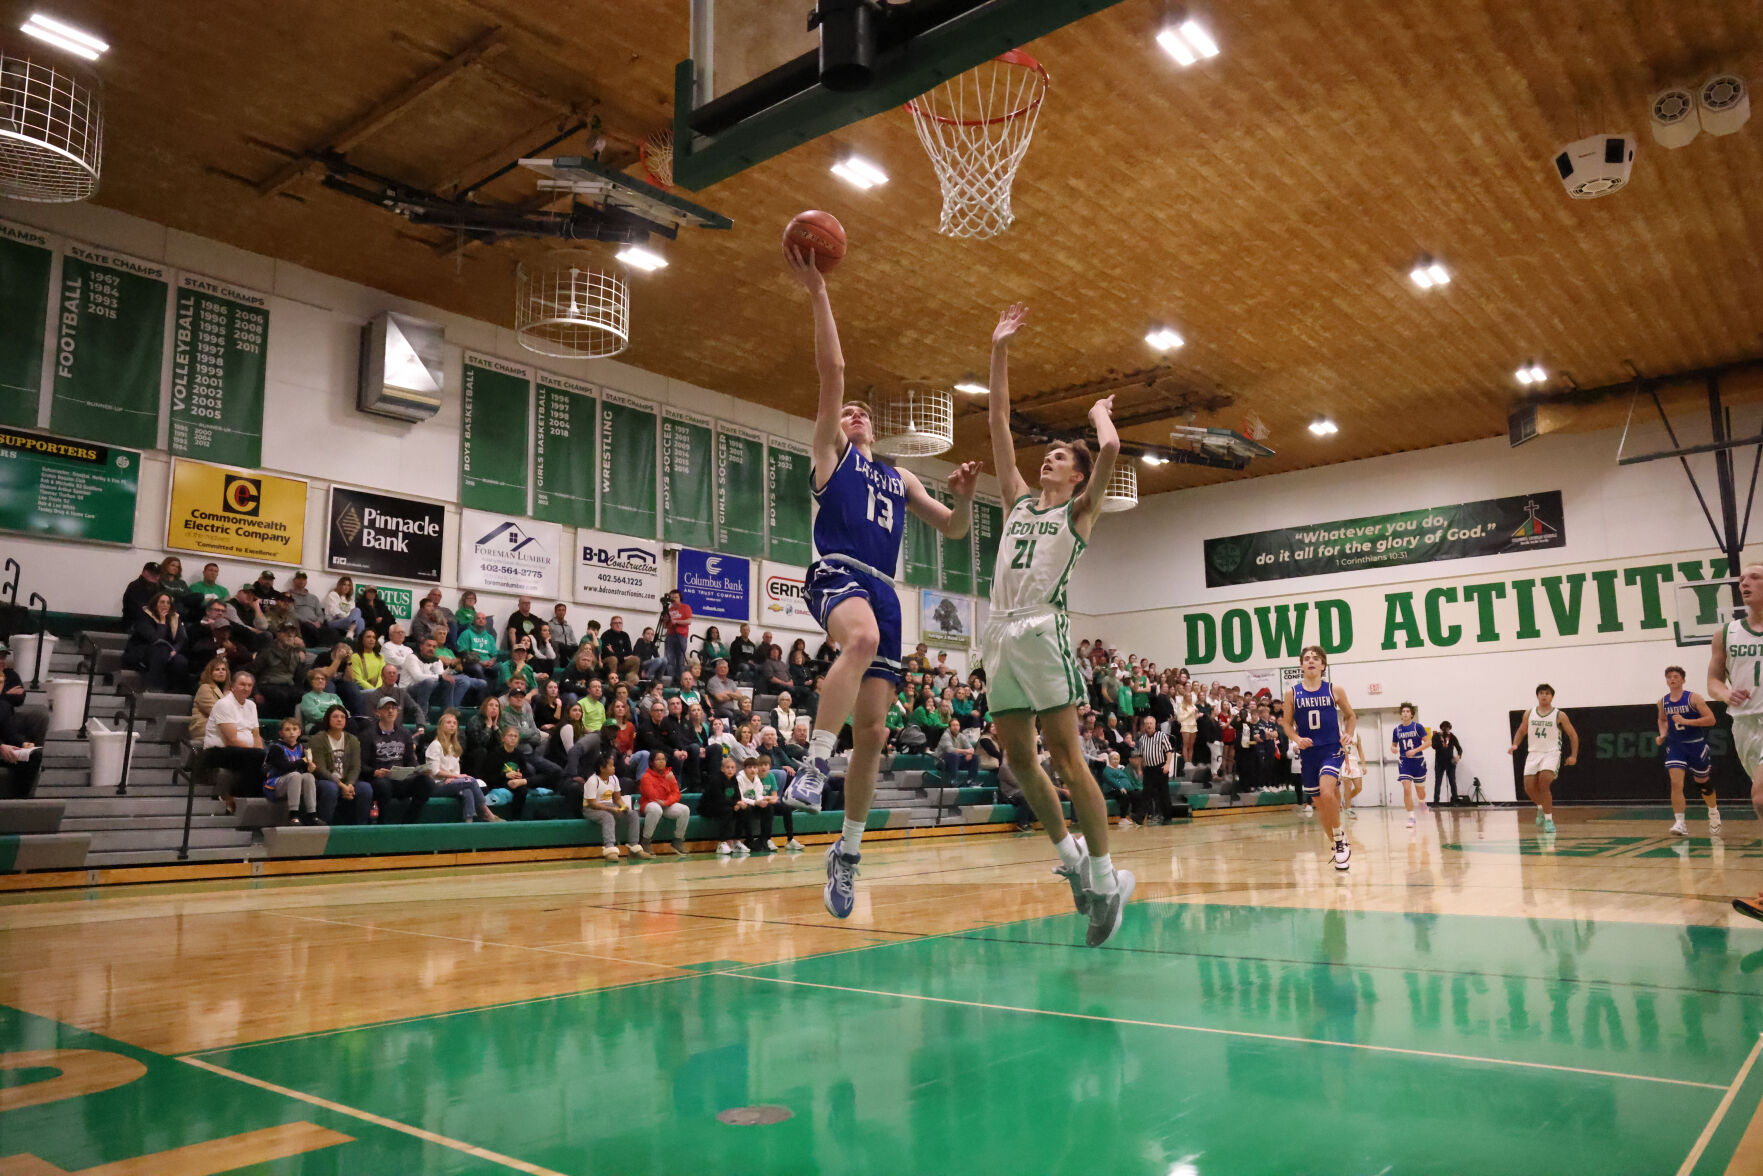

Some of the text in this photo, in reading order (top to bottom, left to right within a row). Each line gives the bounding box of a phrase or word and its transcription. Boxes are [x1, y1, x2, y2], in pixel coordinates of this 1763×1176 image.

[71, 246, 163, 278] STATE CHAMPS
[90, 271, 120, 285] 1967
[89, 281, 119, 297] 1984
[184, 277, 265, 306] STATE CHAMPS
[89, 292, 118, 308] 1993
[201, 300, 228, 314] 1986
[88, 303, 117, 319] 2015
[200, 310, 226, 324] 1990
[58, 277, 82, 378] FOOTBALL
[198, 331, 225, 345] 1996
[236, 341, 259, 353] 2011
[173, 296, 195, 412] VOLLEYBALL
[197, 342, 224, 355] 1997
[196, 352, 224, 366] 1998
[468, 355, 527, 377] STATE CHAMPS
[195, 363, 223, 376] 1999
[195, 374, 223, 387] 2001
[540, 375, 593, 395] STATE CHAMPS
[192, 384, 222, 398] 2002
[192, 395, 222, 409] 2003
[464, 370, 475, 439] BASKETBALL
[190, 406, 222, 419] 2005
[538, 388, 546, 454] BASKETBALL
[0, 434, 97, 460] SUPPORTERS
[602, 410, 613, 493] WRESTLING
[663, 423, 672, 473] SOCCER
[718, 434, 727, 484] SOCCER
[537, 457, 545, 487] GIRLS
[866, 483, 894, 534] 13
[191, 509, 287, 531] Commonwealth
[364, 508, 440, 537] Pinnacle
[1385, 520, 1417, 536] you
[1422, 514, 1449, 529] do,
[184, 519, 230, 534] Electric
[235, 527, 290, 546] Company
[362, 529, 408, 552] Bank
[974, 504, 982, 573] JOURNALISM
[474, 545, 516, 559] FOREMAN
[517, 551, 551, 564] LUMBER
[583, 546, 609, 564] B-D
[1011, 540, 1037, 569] 21
[1256, 552, 1275, 565] do
[1279, 549, 1290, 562] it
[1294, 546, 1314, 560] all
[1318, 543, 1341, 558] for
[1345, 540, 1372, 555] the
[1376, 535, 1420, 555] glory
[1425, 532, 1443, 544] of
[606, 555, 658, 573] Construction
[1341, 554, 1388, 566] Corinthians
[1389, 551, 1408, 561] 10:31
[480, 563, 543, 579] 402-564-2775
[598, 573, 643, 587] 402.564.1225
[684, 572, 743, 591] Columbus Bank
[358, 587, 410, 605] SOTUS
[1184, 557, 1731, 666] DOWD ACTIVITY
[1297, 695, 1332, 709] LAKEVIEW
[1308, 709, 1321, 730] 0
[1534, 727, 1548, 739] 44
[1403, 738, 1414, 750] 14
[1595, 728, 1728, 759] SCOS
